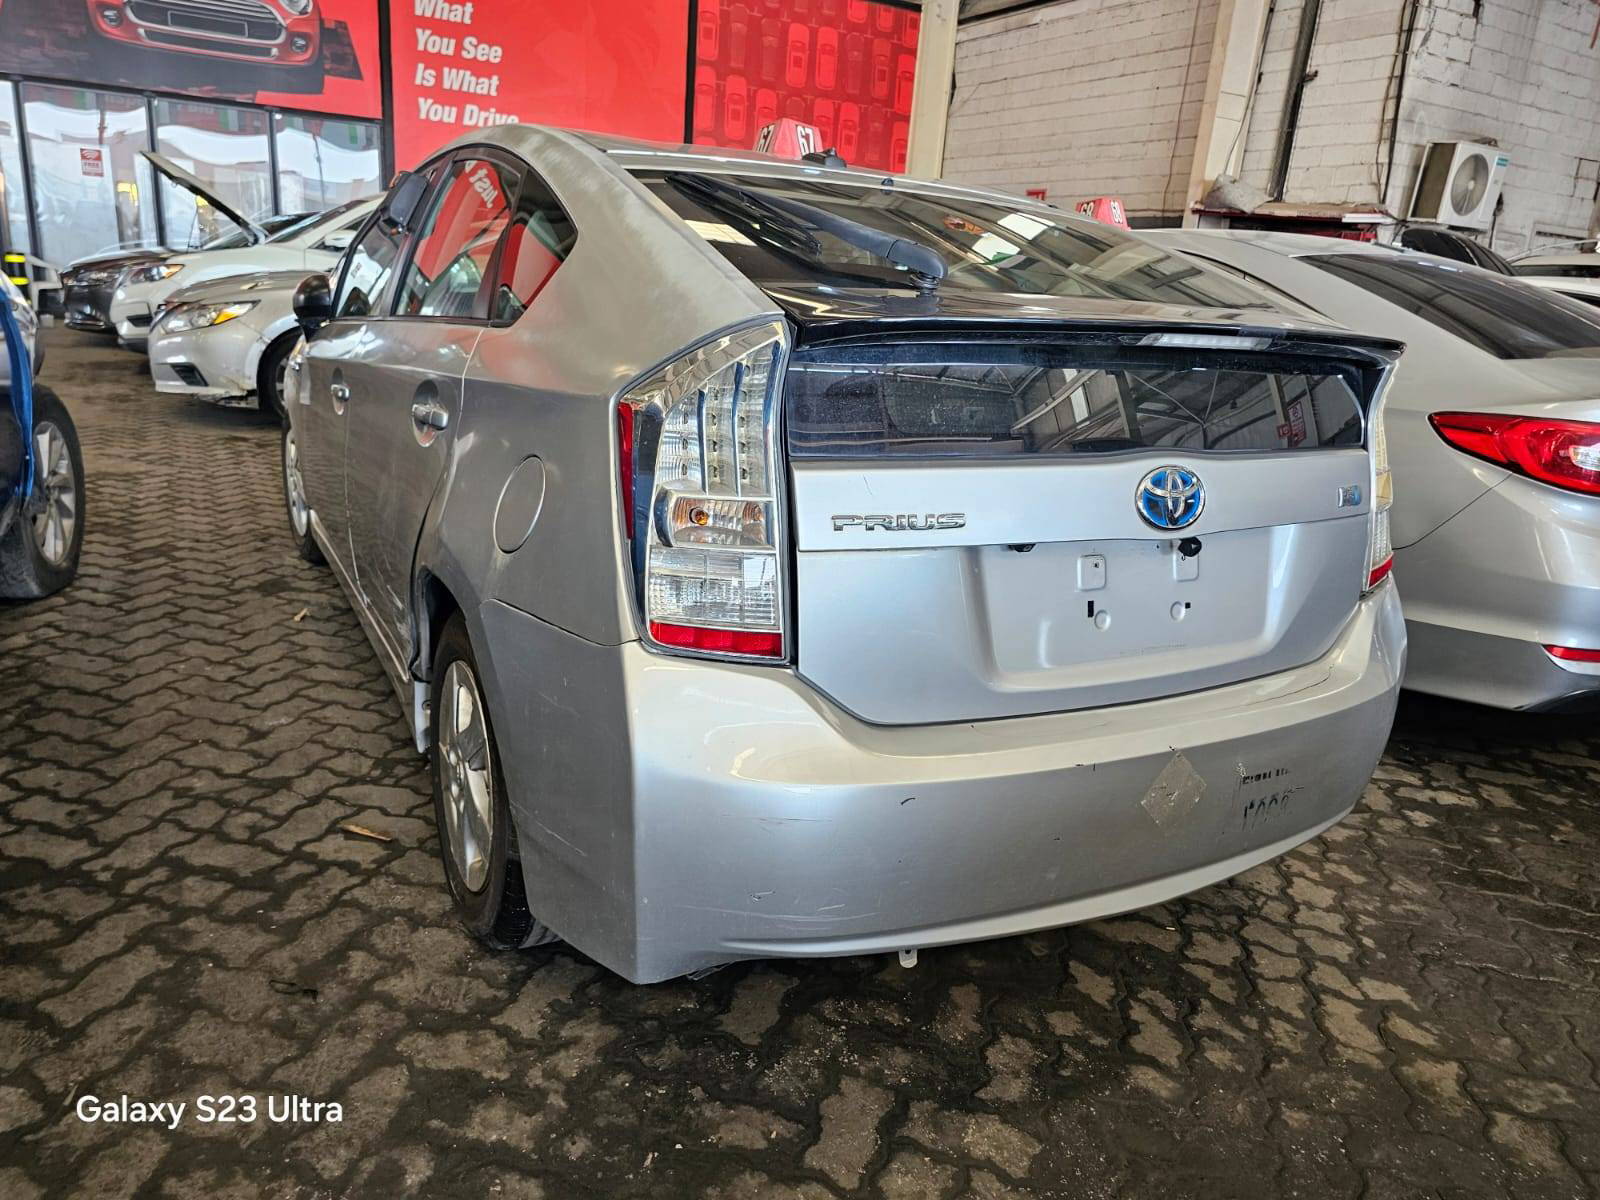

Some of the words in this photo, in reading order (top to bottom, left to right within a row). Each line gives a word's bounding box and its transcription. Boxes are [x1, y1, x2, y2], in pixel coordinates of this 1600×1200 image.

[414, 0, 473, 24] What
[415, 28, 456, 56] You
[461, 36, 502, 63] See
[415, 63, 436, 87] Is
[442, 67, 499, 96] What
[418, 97, 457, 123] You
[797, 125, 815, 156] 67
[831, 513, 966, 531] PRIUS
